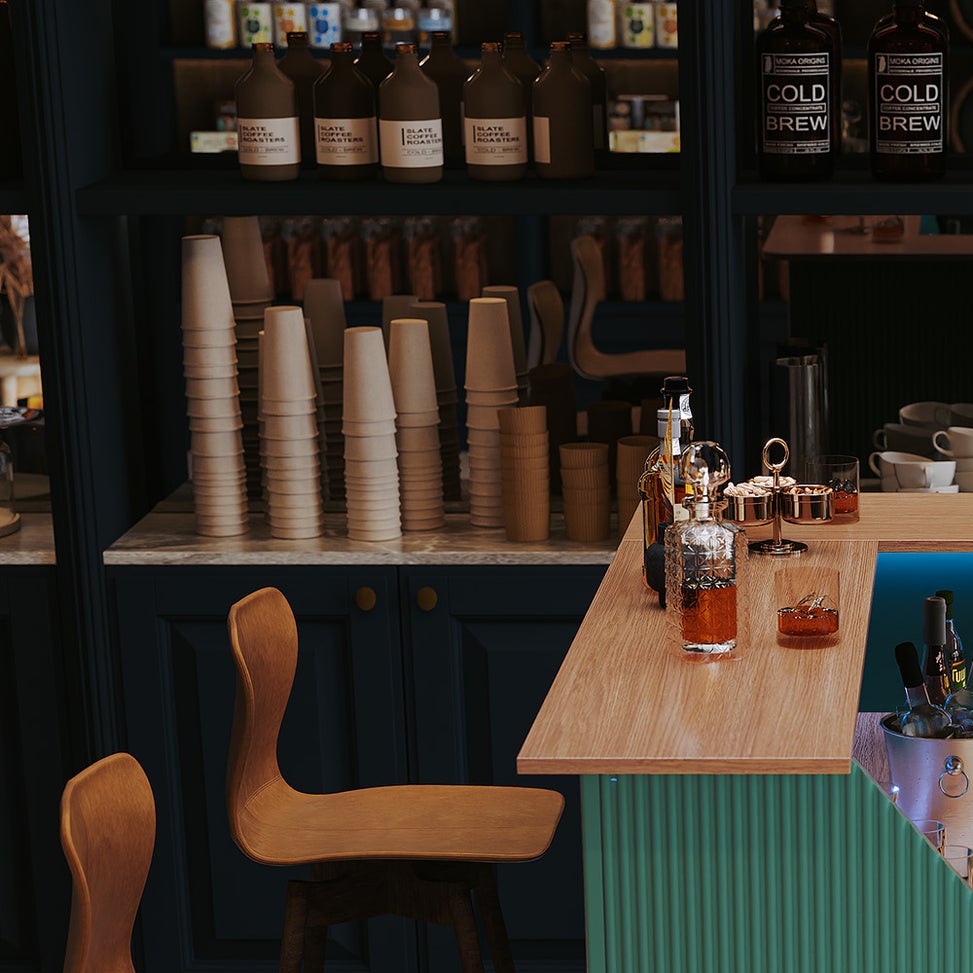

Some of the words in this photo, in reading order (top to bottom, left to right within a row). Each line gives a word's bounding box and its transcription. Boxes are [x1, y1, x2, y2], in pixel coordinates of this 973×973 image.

[776, 57, 797, 65] MOKA
[890, 57, 911, 65] MOKA
[767, 84, 825, 102] COLD
[881, 84, 938, 102] COLD
[766, 115, 827, 131] BREW
[880, 115, 940, 131] BREW
